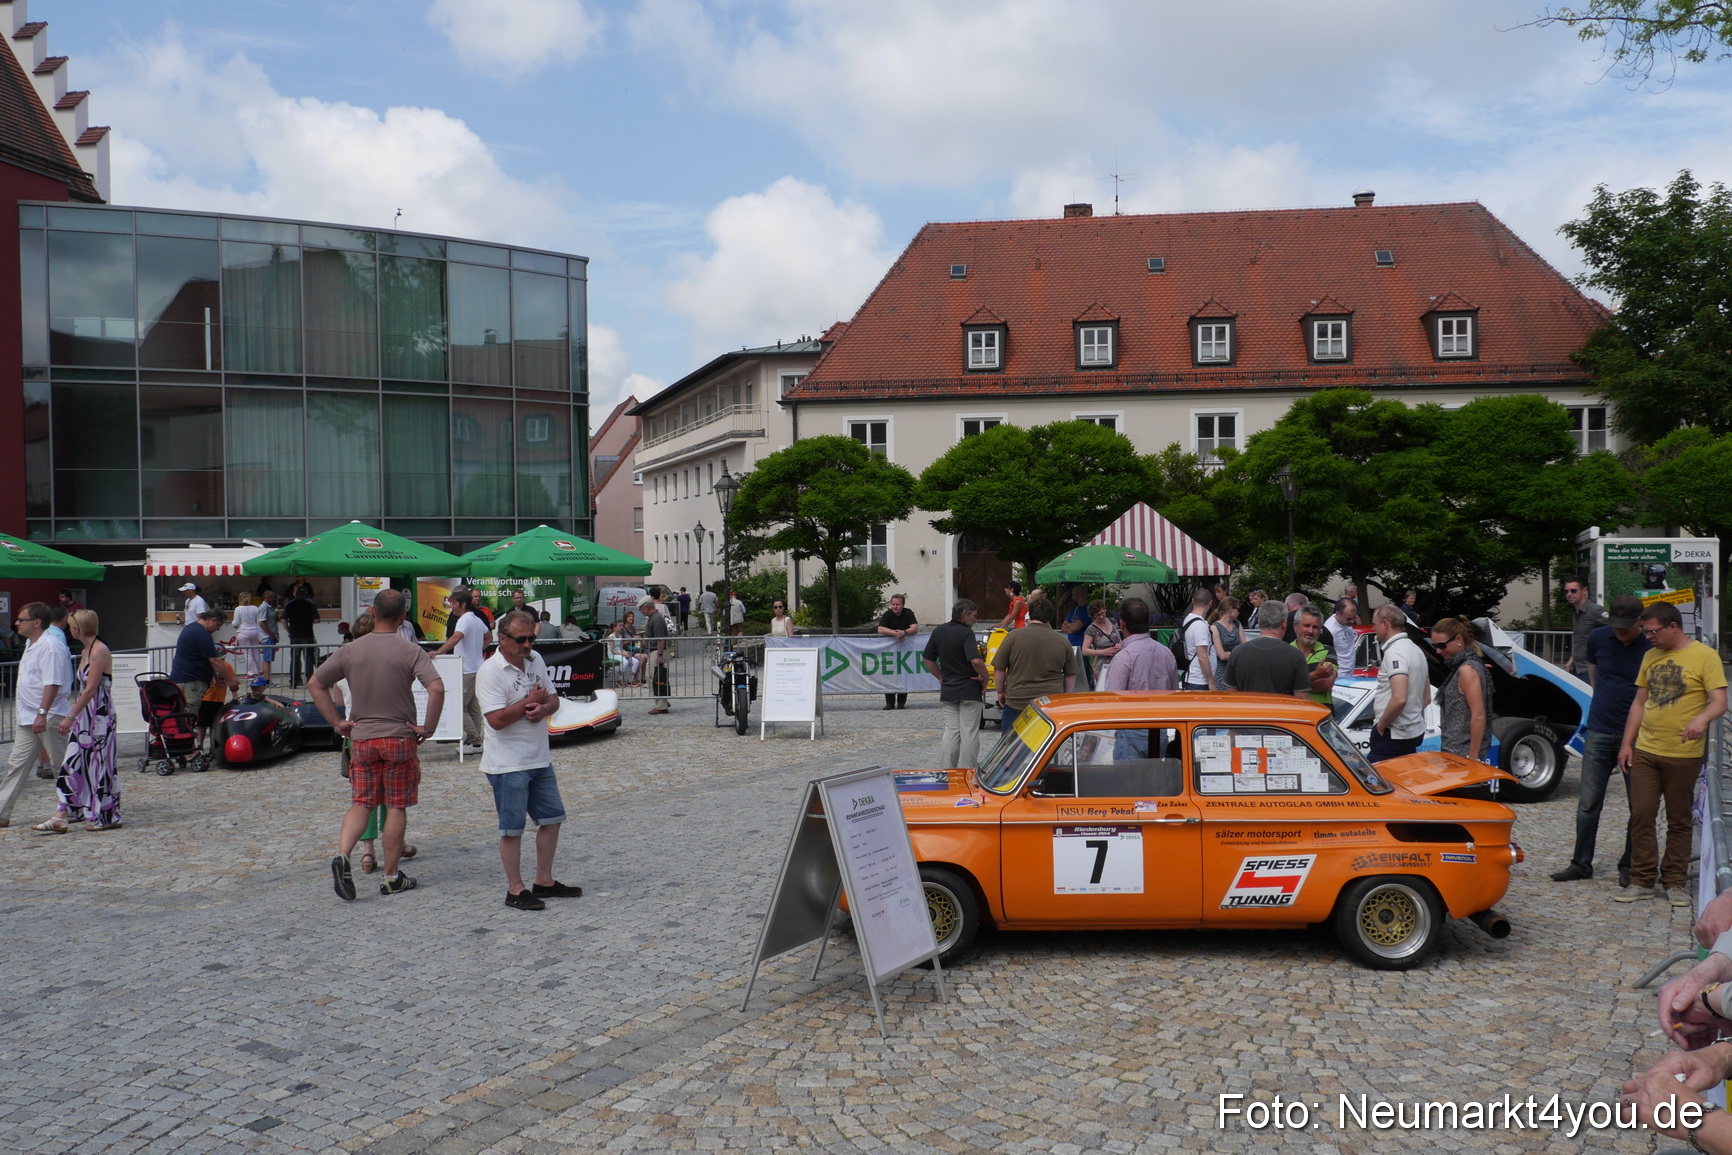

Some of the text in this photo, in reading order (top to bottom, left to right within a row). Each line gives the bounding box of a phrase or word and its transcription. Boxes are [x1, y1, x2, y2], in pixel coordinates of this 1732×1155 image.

[345, 552, 418, 560] Lammsbräu
[1684, 550, 1711, 558] DEKRA
[466, 577, 527, 588] Verantwortung
[422, 609, 447, 626] Lamms
[861, 650, 929, 676] DEKR
[858, 796, 876, 807] DEKRA
[1060, 807, 1135, 817] NSU Berg Pokal
[1215, 829, 1302, 840] sälzer motorsport
[1340, 828, 1377, 837] autoteile
[1086, 840, 1108, 884] 7
[1380, 853, 1432, 862] EINFALT
[1244, 858, 1310, 871] SPIESS
[1229, 894, 1293, 906] TUNING
